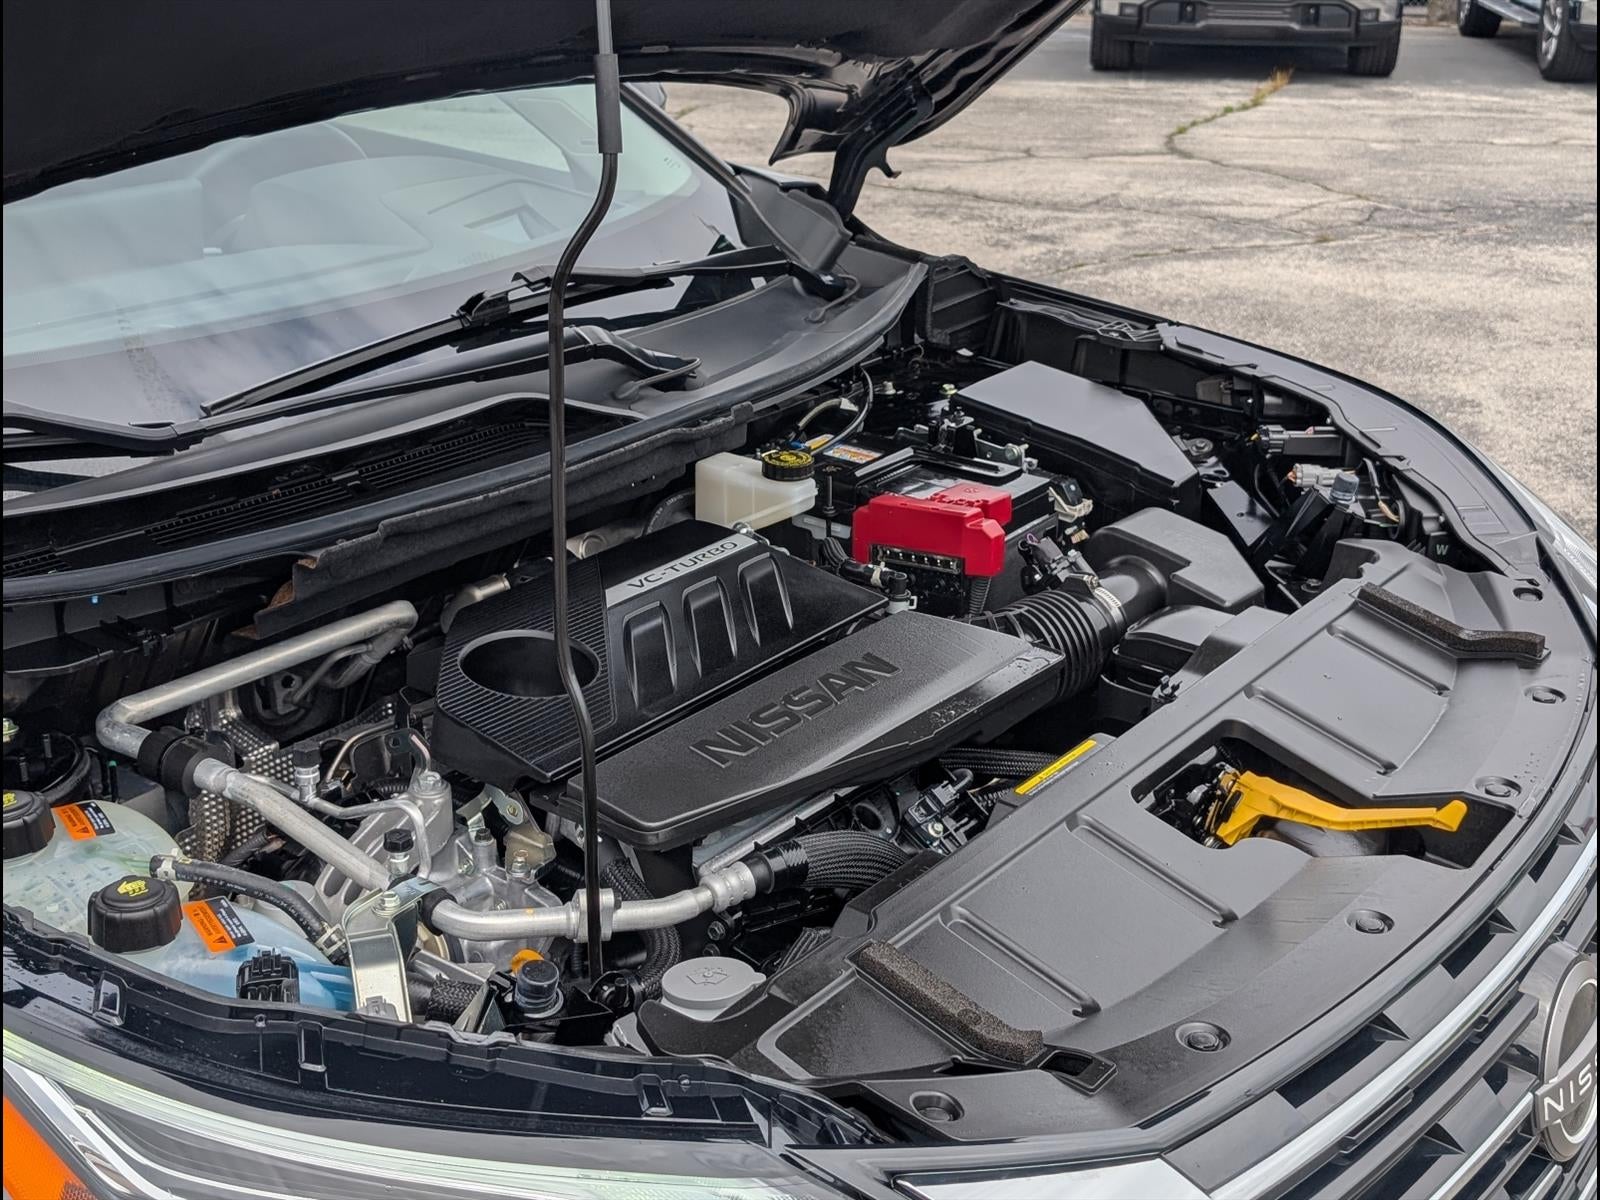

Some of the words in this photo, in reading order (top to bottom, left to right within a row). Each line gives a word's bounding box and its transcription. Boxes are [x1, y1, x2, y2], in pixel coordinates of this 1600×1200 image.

[627, 541, 738, 589] VC-TURBO
[1436, 544, 1449, 556] W
[689, 652, 902, 768] NISSAN
[1544, 1053, 1597, 1121] NIS
